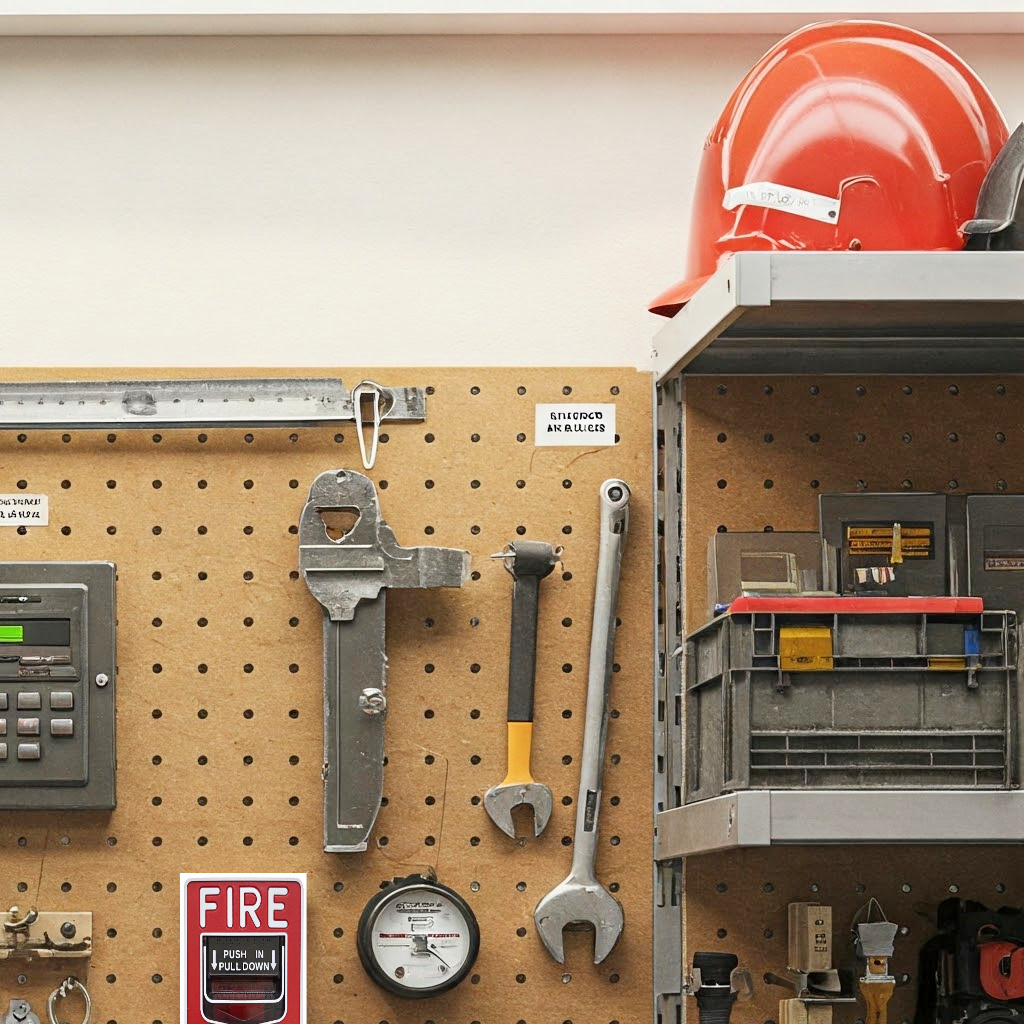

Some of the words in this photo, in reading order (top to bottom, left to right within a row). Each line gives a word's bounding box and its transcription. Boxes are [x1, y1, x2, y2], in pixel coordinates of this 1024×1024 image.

[199, 886, 289, 929] FIRE
[223, 949, 247, 959] PUSH
[255, 949, 264, 959] IN
[218, 961, 241, 971] PULL
[242, 961, 270, 971] DOWN
